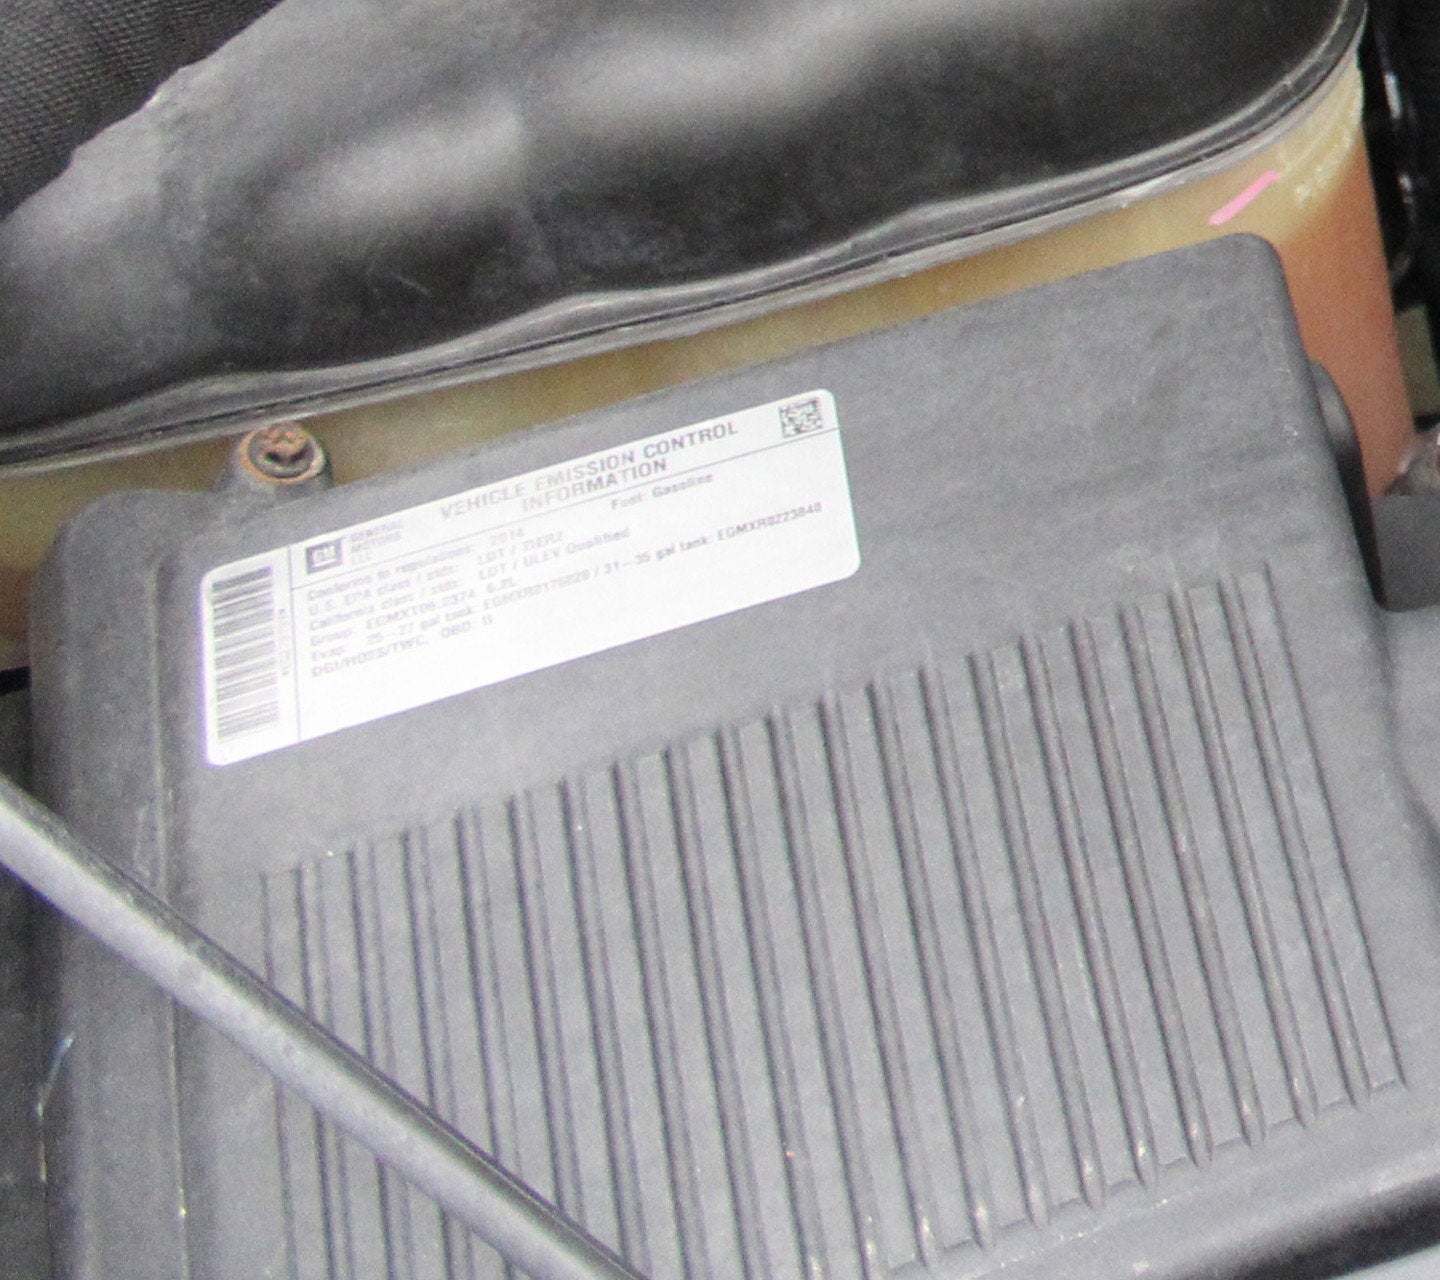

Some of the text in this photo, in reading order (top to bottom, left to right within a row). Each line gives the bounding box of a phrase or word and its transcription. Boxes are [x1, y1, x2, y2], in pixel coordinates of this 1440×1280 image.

[440, 422, 738, 519] VEHICLE EMISSION CONTROL
[522, 459, 667, 511] INFORMATION
[652, 473, 712, 497] Gasoline
[566, 528, 629, 553] Qualified
